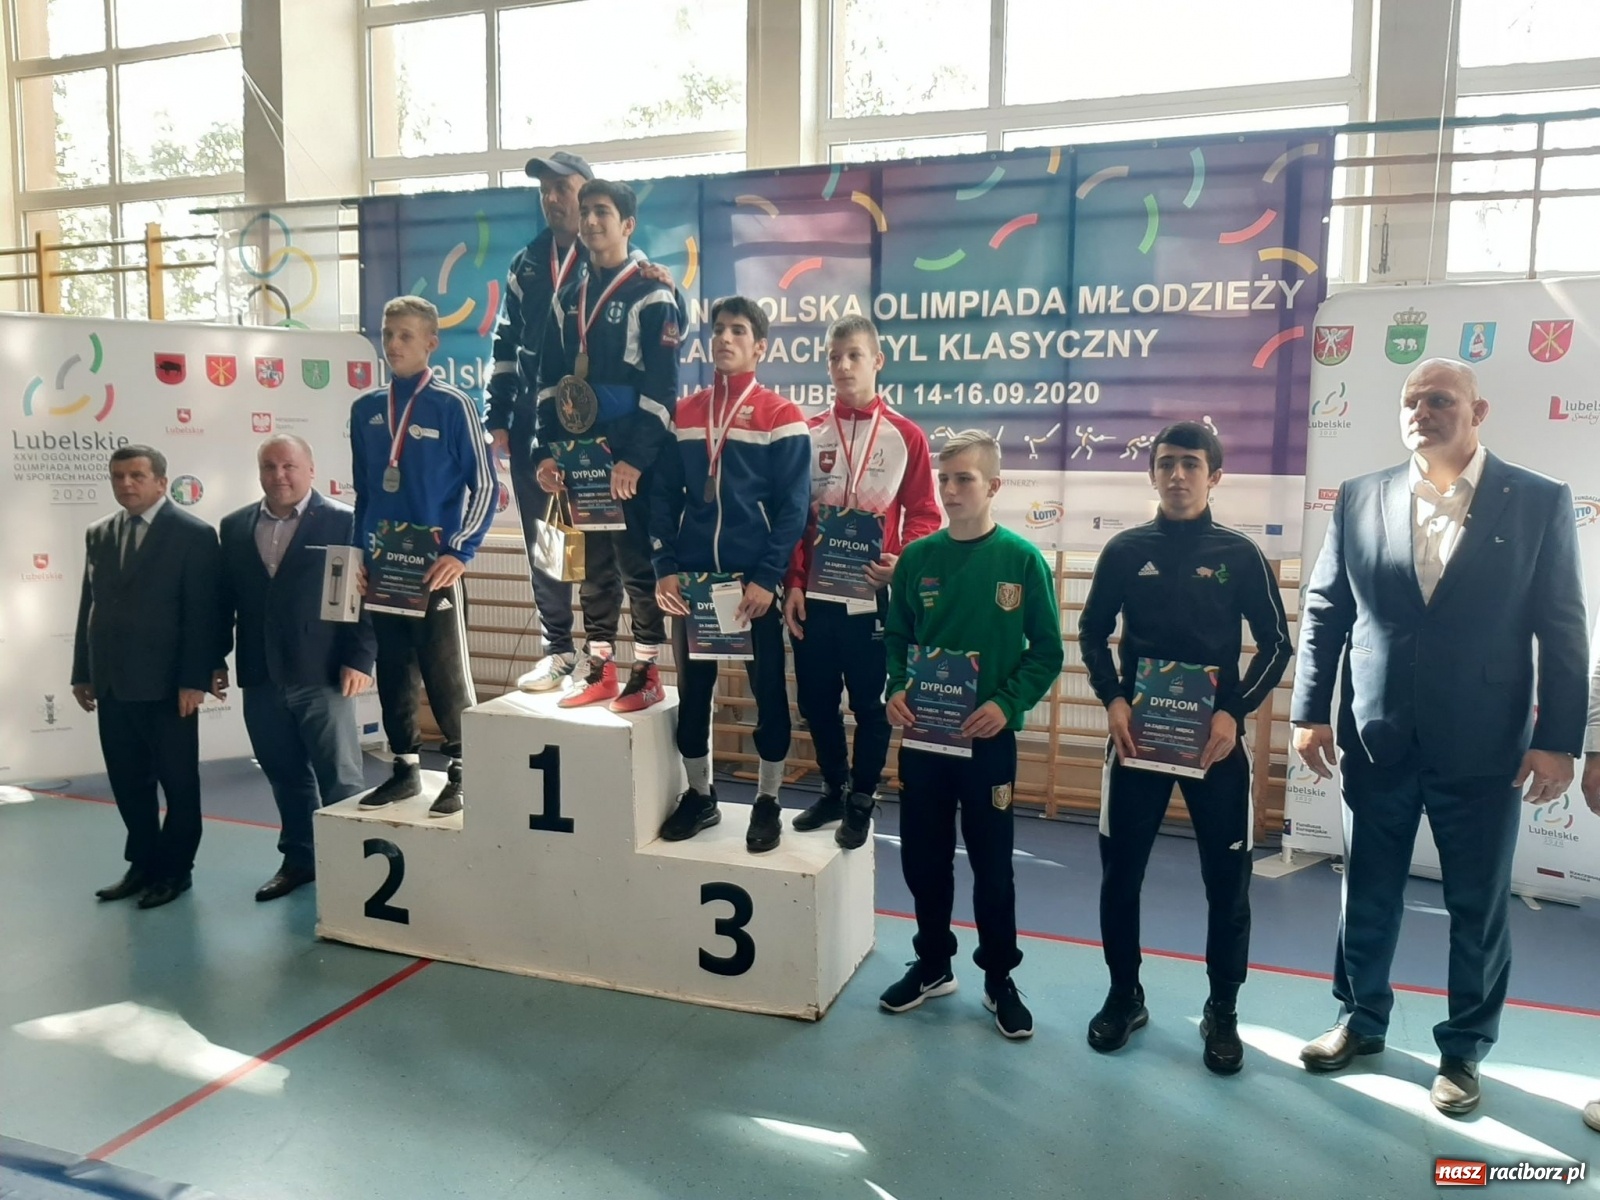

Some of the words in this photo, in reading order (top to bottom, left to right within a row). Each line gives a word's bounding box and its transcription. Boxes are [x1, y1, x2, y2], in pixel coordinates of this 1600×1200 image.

[873, 286, 1066, 321] OLIMPIADA
[1078, 273, 1305, 314] MŁODZIEŻY
[938, 328, 1159, 361] KLASYCZNY
[913, 381, 1100, 406] 14-16.09.2020
[1565, 400, 1600, 412] lubel
[11, 429, 129, 451] Lubelskie
[41, 452, 113, 461] OGÓLNOPOL
[13, 463, 71, 472] OLIMPIADA
[74, 463, 109, 472] MŁODZ
[571, 469, 607, 479] DYPLOM
[26, 473, 76, 481] SPORTACH
[78, 472, 112, 481] HAŁOW
[52, 488, 97, 500] 2020
[1033, 508, 1057, 520] LOTTO
[829, 537, 870, 552] DYPLOM
[386, 552, 425, 565] DYPLOM
[696, 602, 716, 610] DYP
[920, 681, 963, 695] DYPLOM
[1150, 696, 1199, 711] DYPLOM
[529, 744, 575, 834] 1
[1287, 785, 1326, 797] ubelskie
[1528, 825, 1579, 842] Lubelskie
[363, 838, 410, 926] 2
[699, 881, 756, 977] 3
